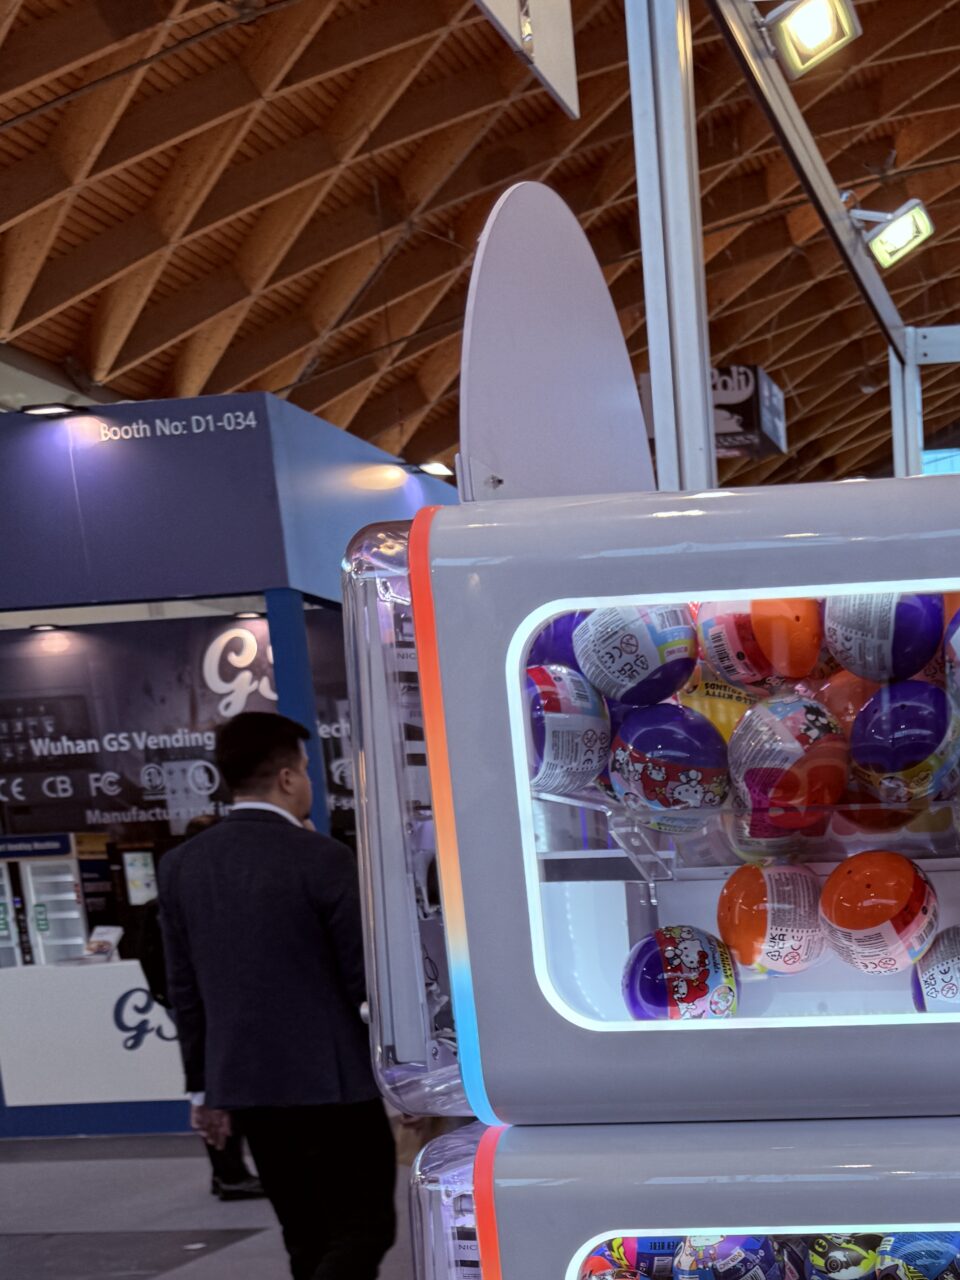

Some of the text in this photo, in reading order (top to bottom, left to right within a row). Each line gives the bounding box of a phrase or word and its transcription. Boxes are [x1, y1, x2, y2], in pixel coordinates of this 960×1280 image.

[100, 411, 257, 441] Booth No: D1-034
[31, 736, 99, 756] Wuhan
[103, 732, 130, 752] GS
[131, 728, 216, 751] Vending
[42, 775, 73, 798] CB
